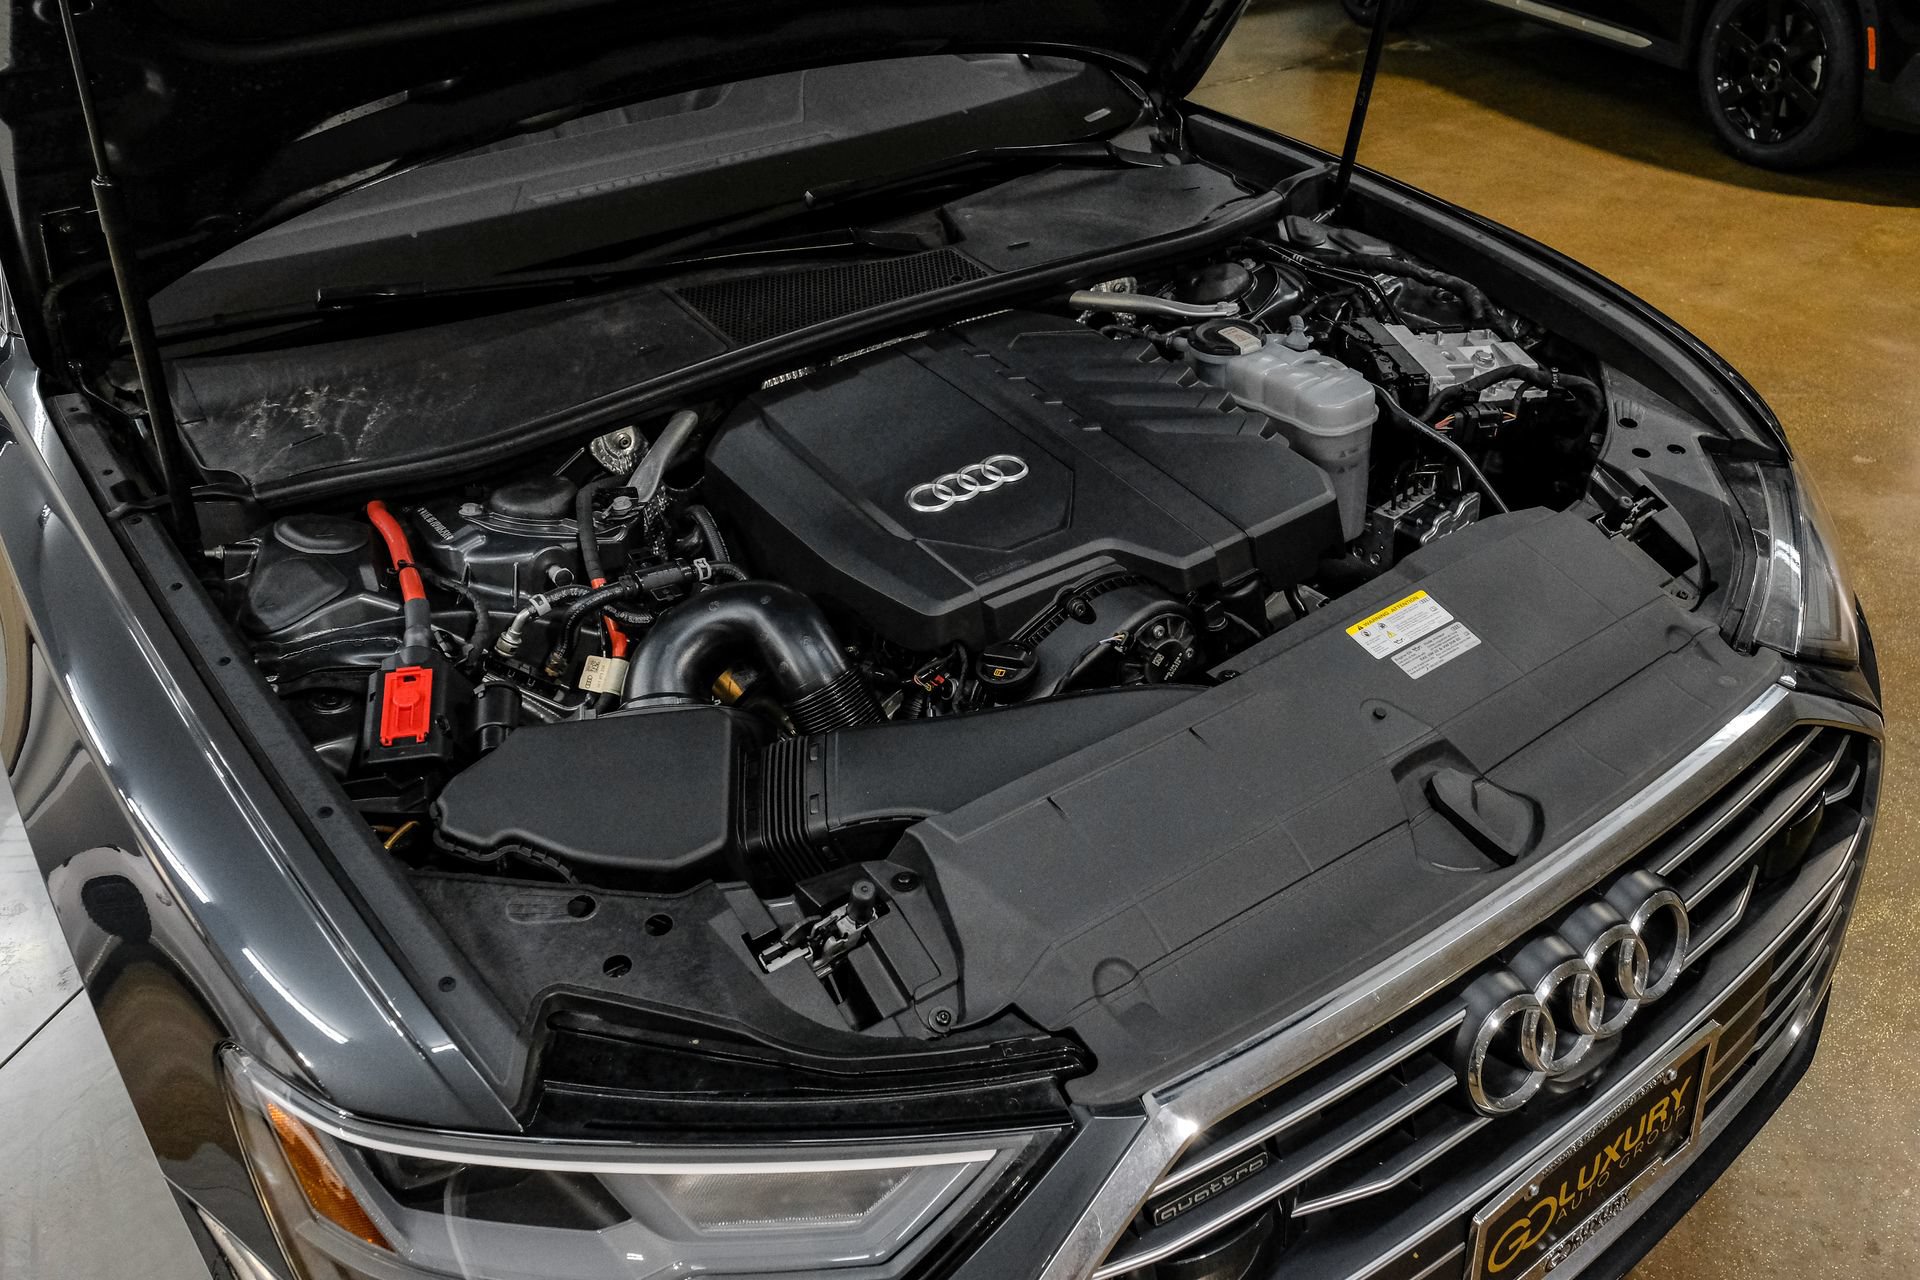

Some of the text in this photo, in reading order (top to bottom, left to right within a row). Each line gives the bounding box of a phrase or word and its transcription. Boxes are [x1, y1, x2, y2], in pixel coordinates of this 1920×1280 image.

[1363, 611, 1389, 627] WARNING
[1391, 596, 1419, 613] ATTENTION
[1160, 1158, 1264, 1221] quattro
[1555, 1171, 1610, 1224] AUTO
[1618, 1104, 1686, 1169] GROUP
